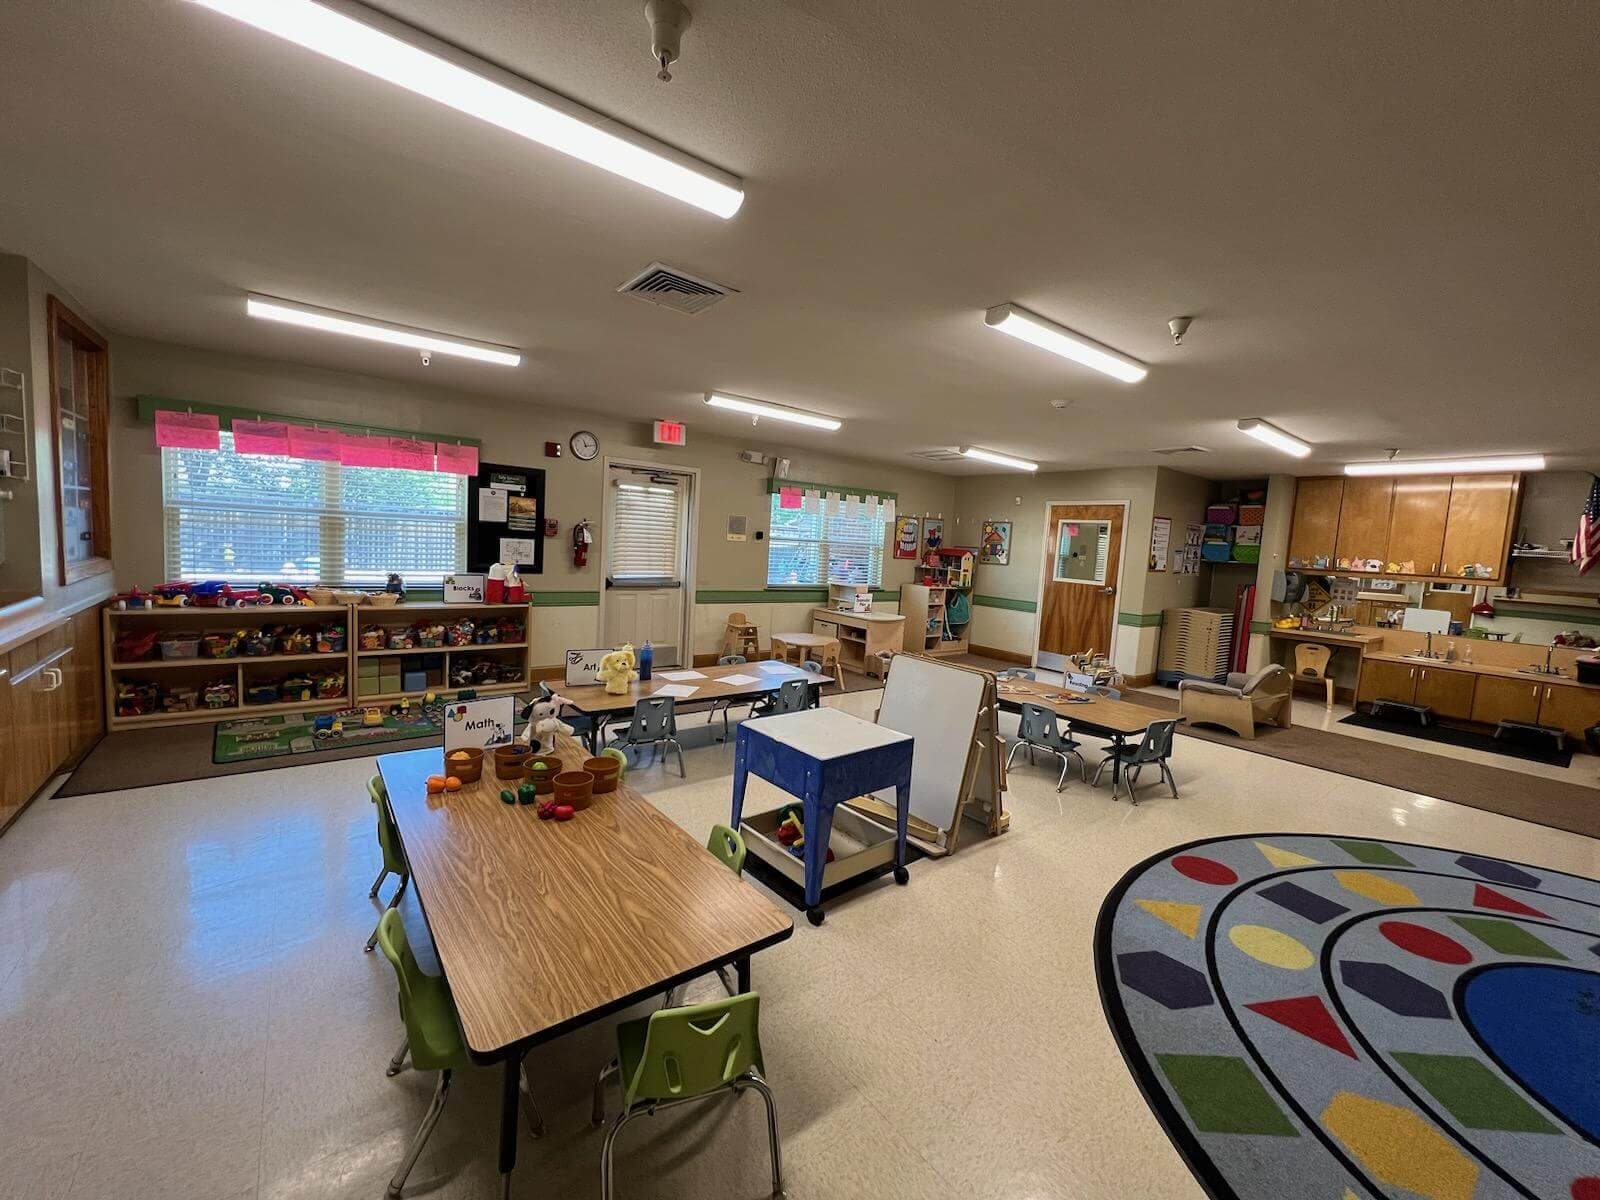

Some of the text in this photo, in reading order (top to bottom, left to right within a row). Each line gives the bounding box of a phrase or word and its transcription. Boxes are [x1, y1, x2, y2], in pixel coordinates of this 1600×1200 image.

[659, 422, 681, 442] EXIT
[583, 662, 596, 672] Art
[465, 718, 495, 731] Math
